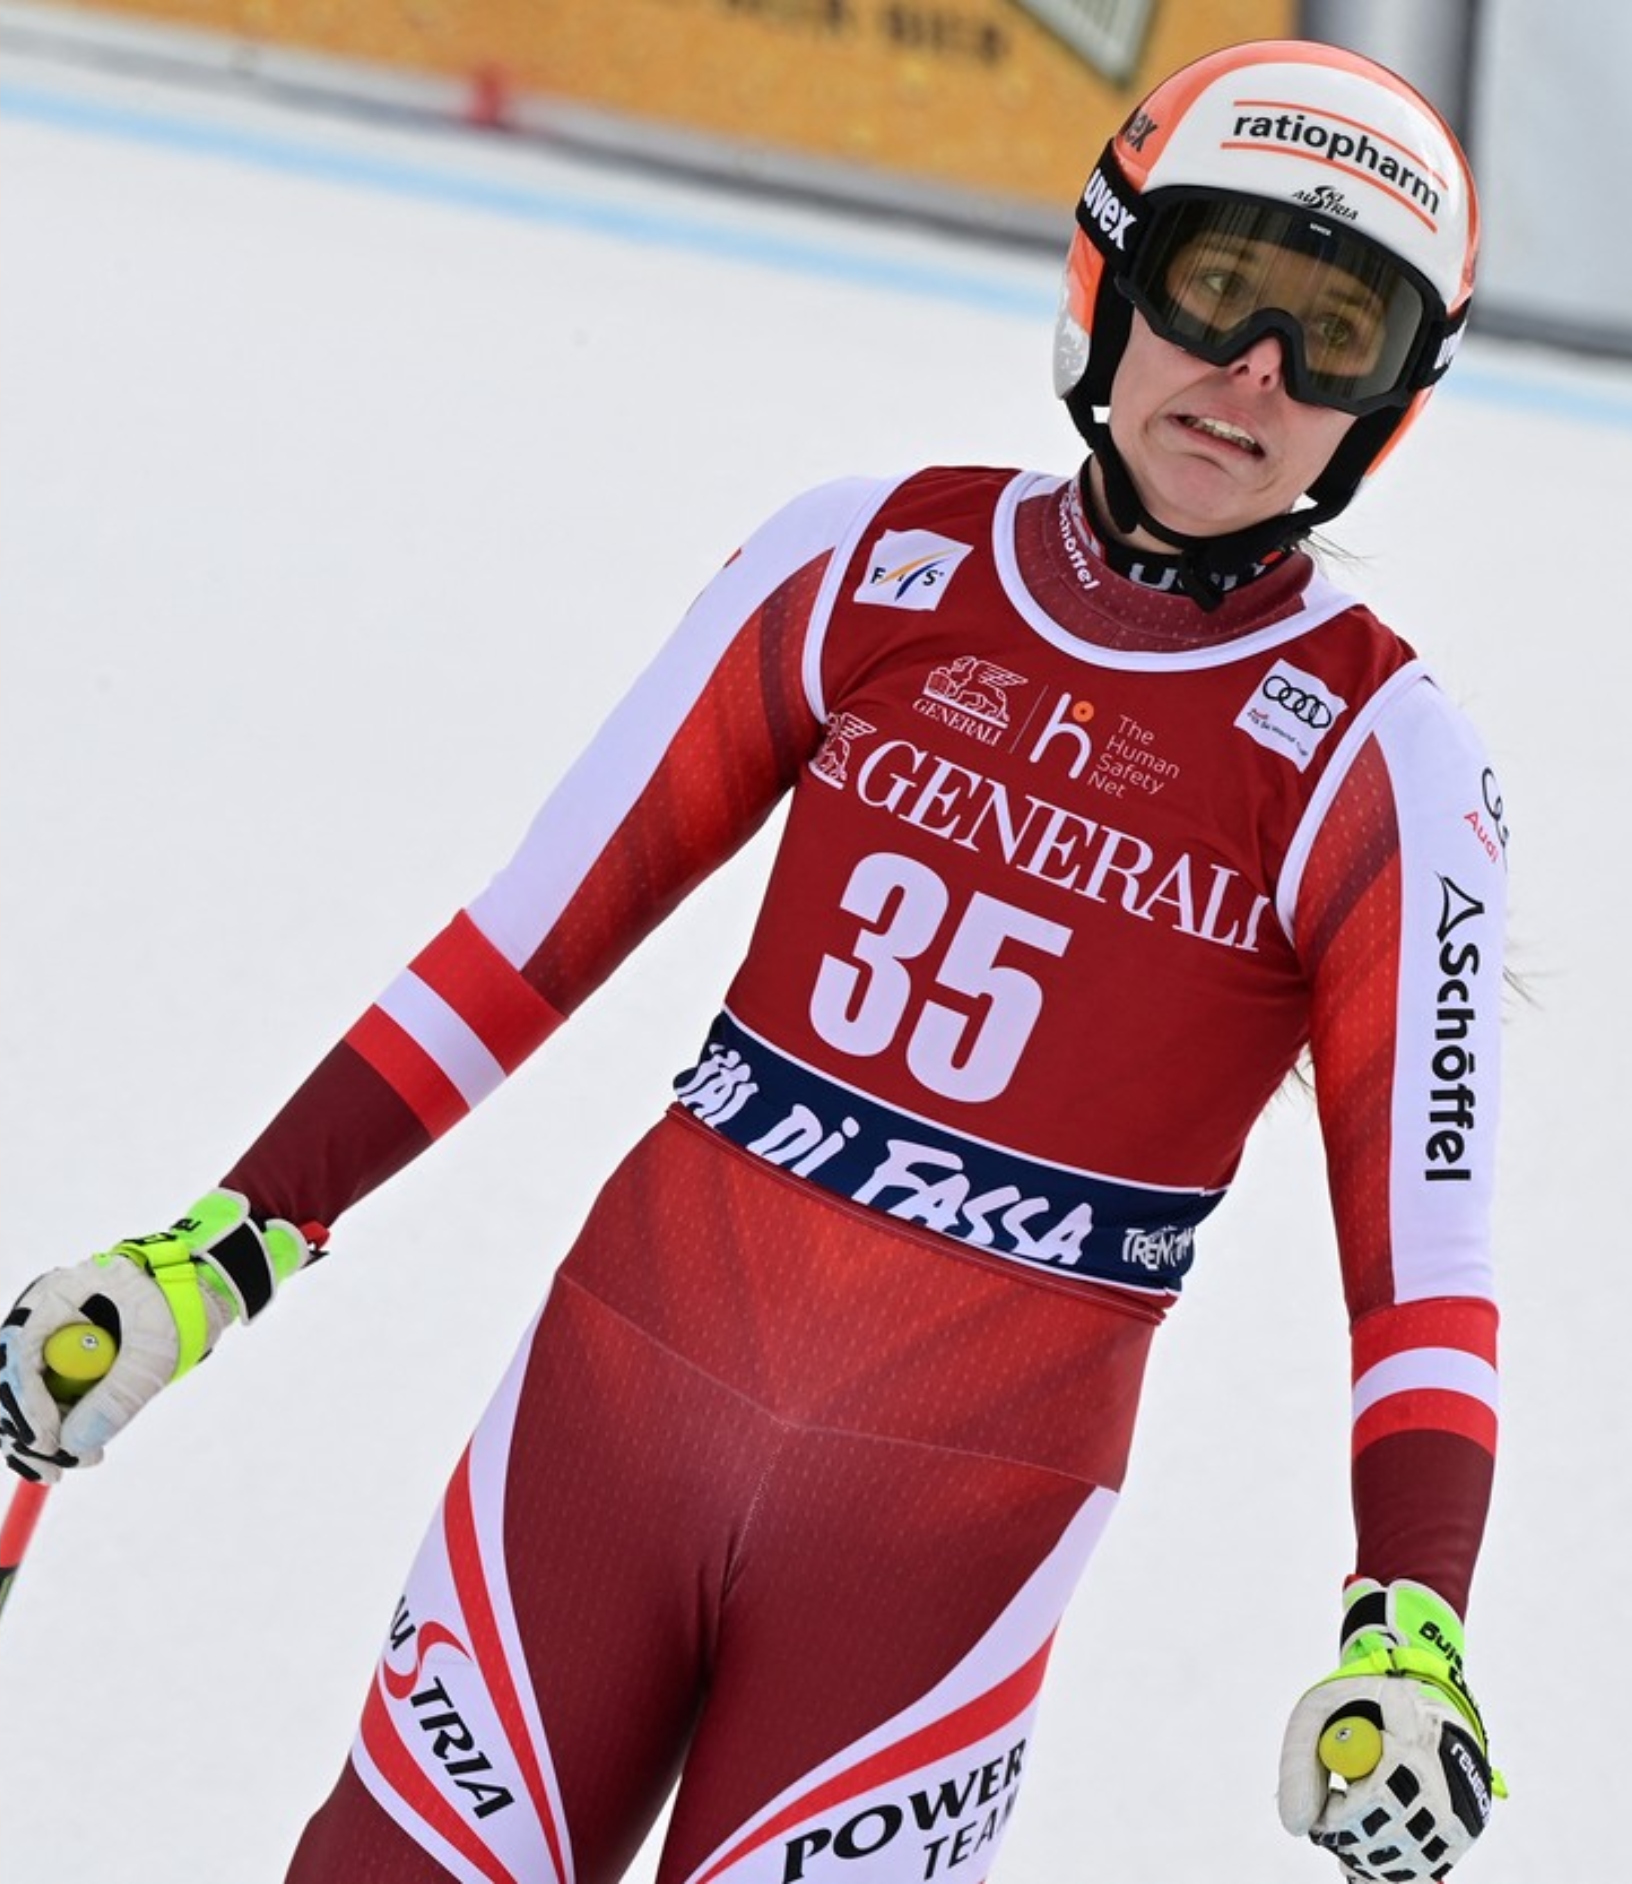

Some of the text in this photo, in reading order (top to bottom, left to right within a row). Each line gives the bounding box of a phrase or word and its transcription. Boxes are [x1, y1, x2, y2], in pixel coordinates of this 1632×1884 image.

[1083, 167, 1138, 251] uvex
[1233, 114, 1440, 216] ratiopharm
[912, 698, 1003, 748] GENERALI
[1106, 733, 1181, 780] Human
[1119, 713, 1156, 746] The
[1086, 769, 1126, 800] Net
[1096, 751, 1166, 797] Safety
[855, 738, 1272, 954] GENERALI
[808, 851, 1074, 1104] 35
[1424, 941, 1481, 1182] Schöffel
[850, 1138, 1093, 1266] FASSA
[782, 1737, 1027, 1884] POWER
